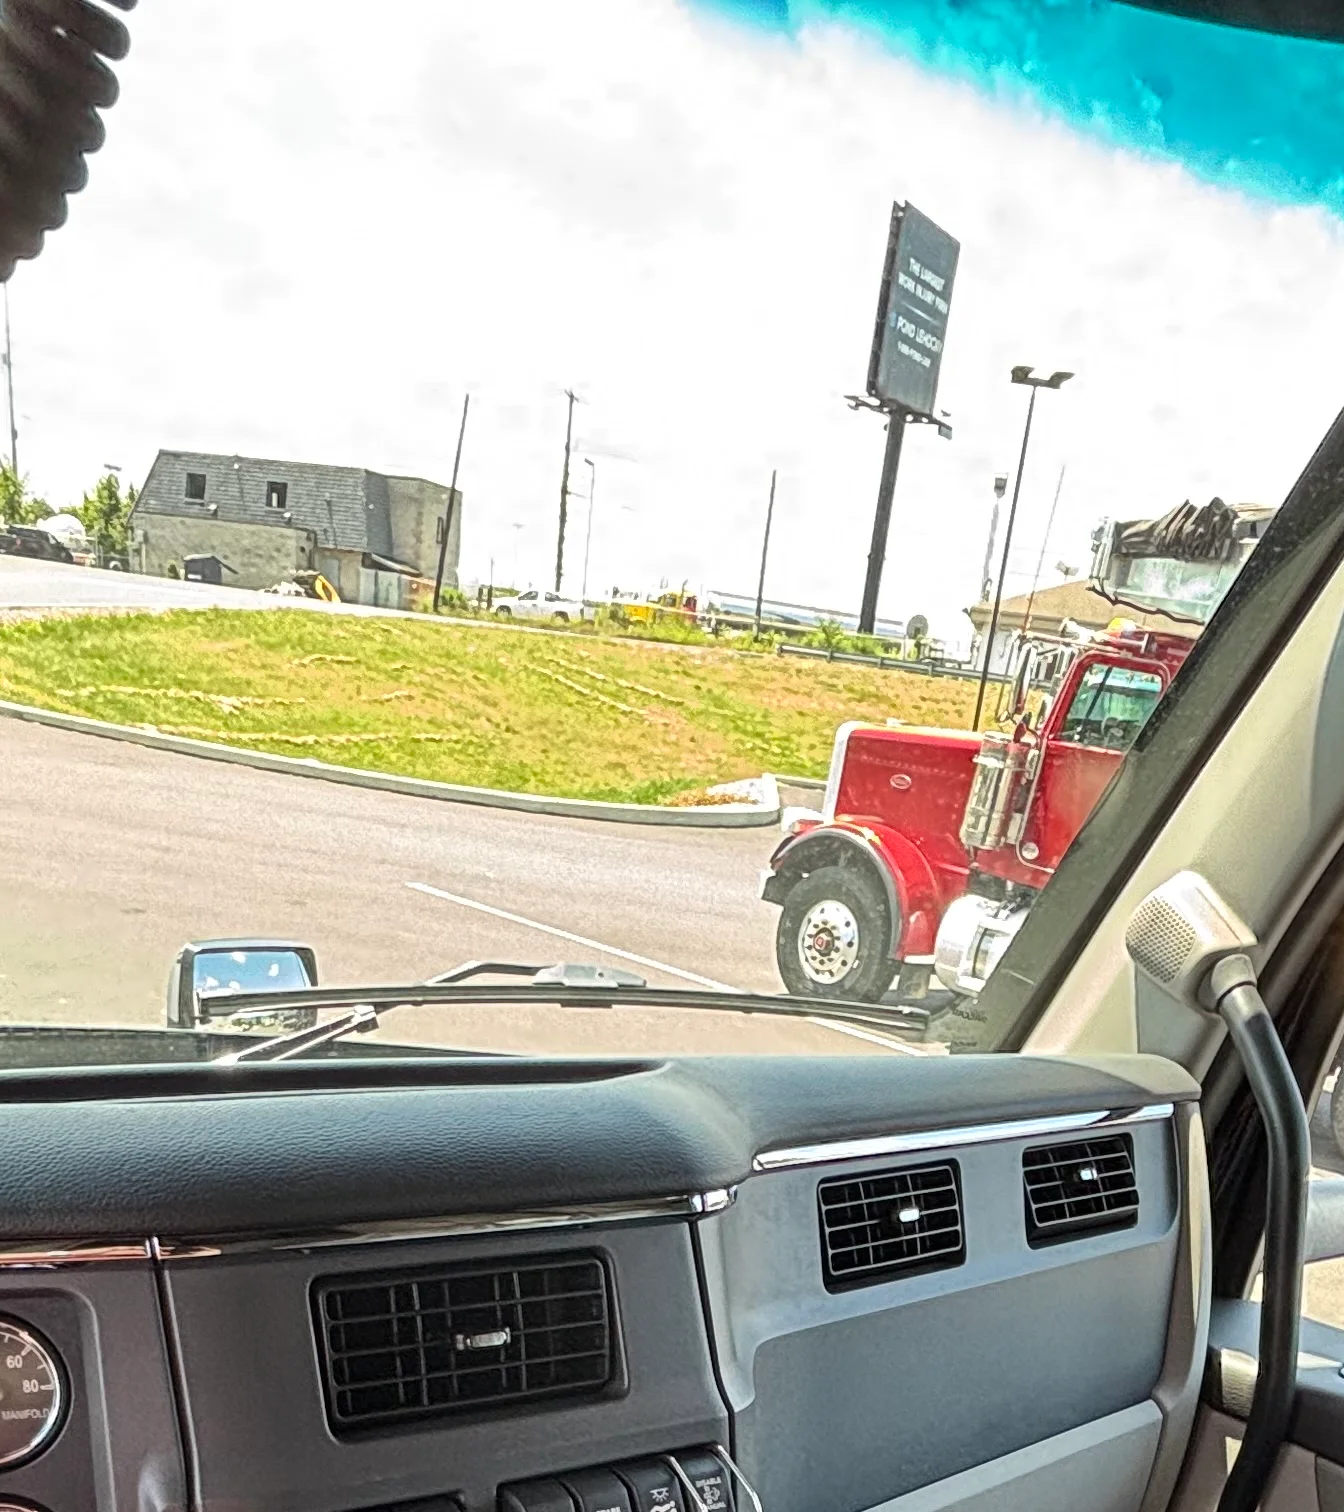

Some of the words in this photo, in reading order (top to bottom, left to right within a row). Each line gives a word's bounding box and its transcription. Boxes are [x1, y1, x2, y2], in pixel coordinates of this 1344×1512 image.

[6, 1356, 23, 1369] 60
[22, 1379, 39, 1393] 80
[1, 1408, 50, 1420] MANIFOLD
